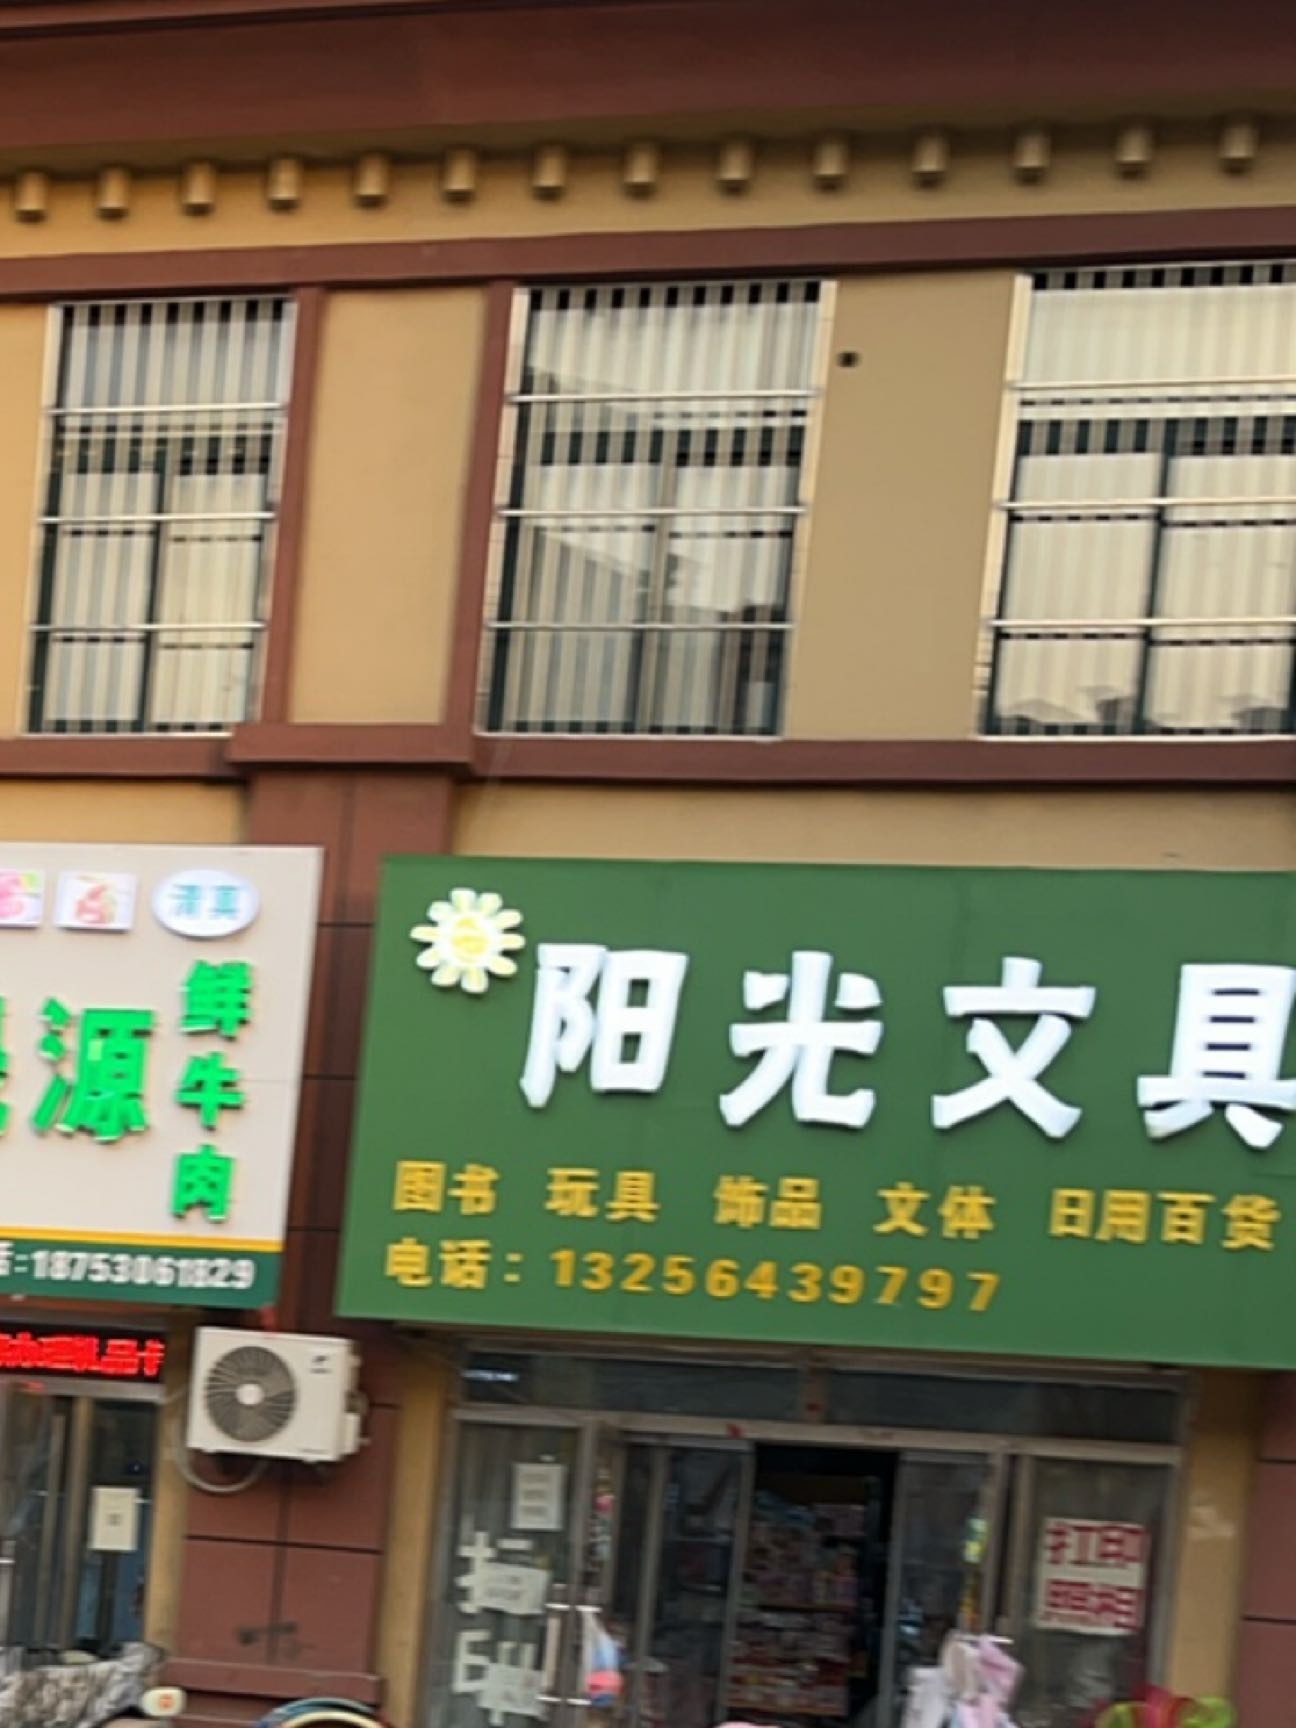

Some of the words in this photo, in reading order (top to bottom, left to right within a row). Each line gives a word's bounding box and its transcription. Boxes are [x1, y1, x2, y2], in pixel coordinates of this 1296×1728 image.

[171, 957, 255, 1228] 鲜牛肉
[520, 942, 1296, 1150] 阳光文具
[392, 1159, 500, 1217] 图书
[545, 1166, 659, 1223] 玩具
[713, 1173, 822, 1231] 饰品
[873, 1182, 998, 1240] 文体
[1048, 1187, 1280, 1252] 日用百货
